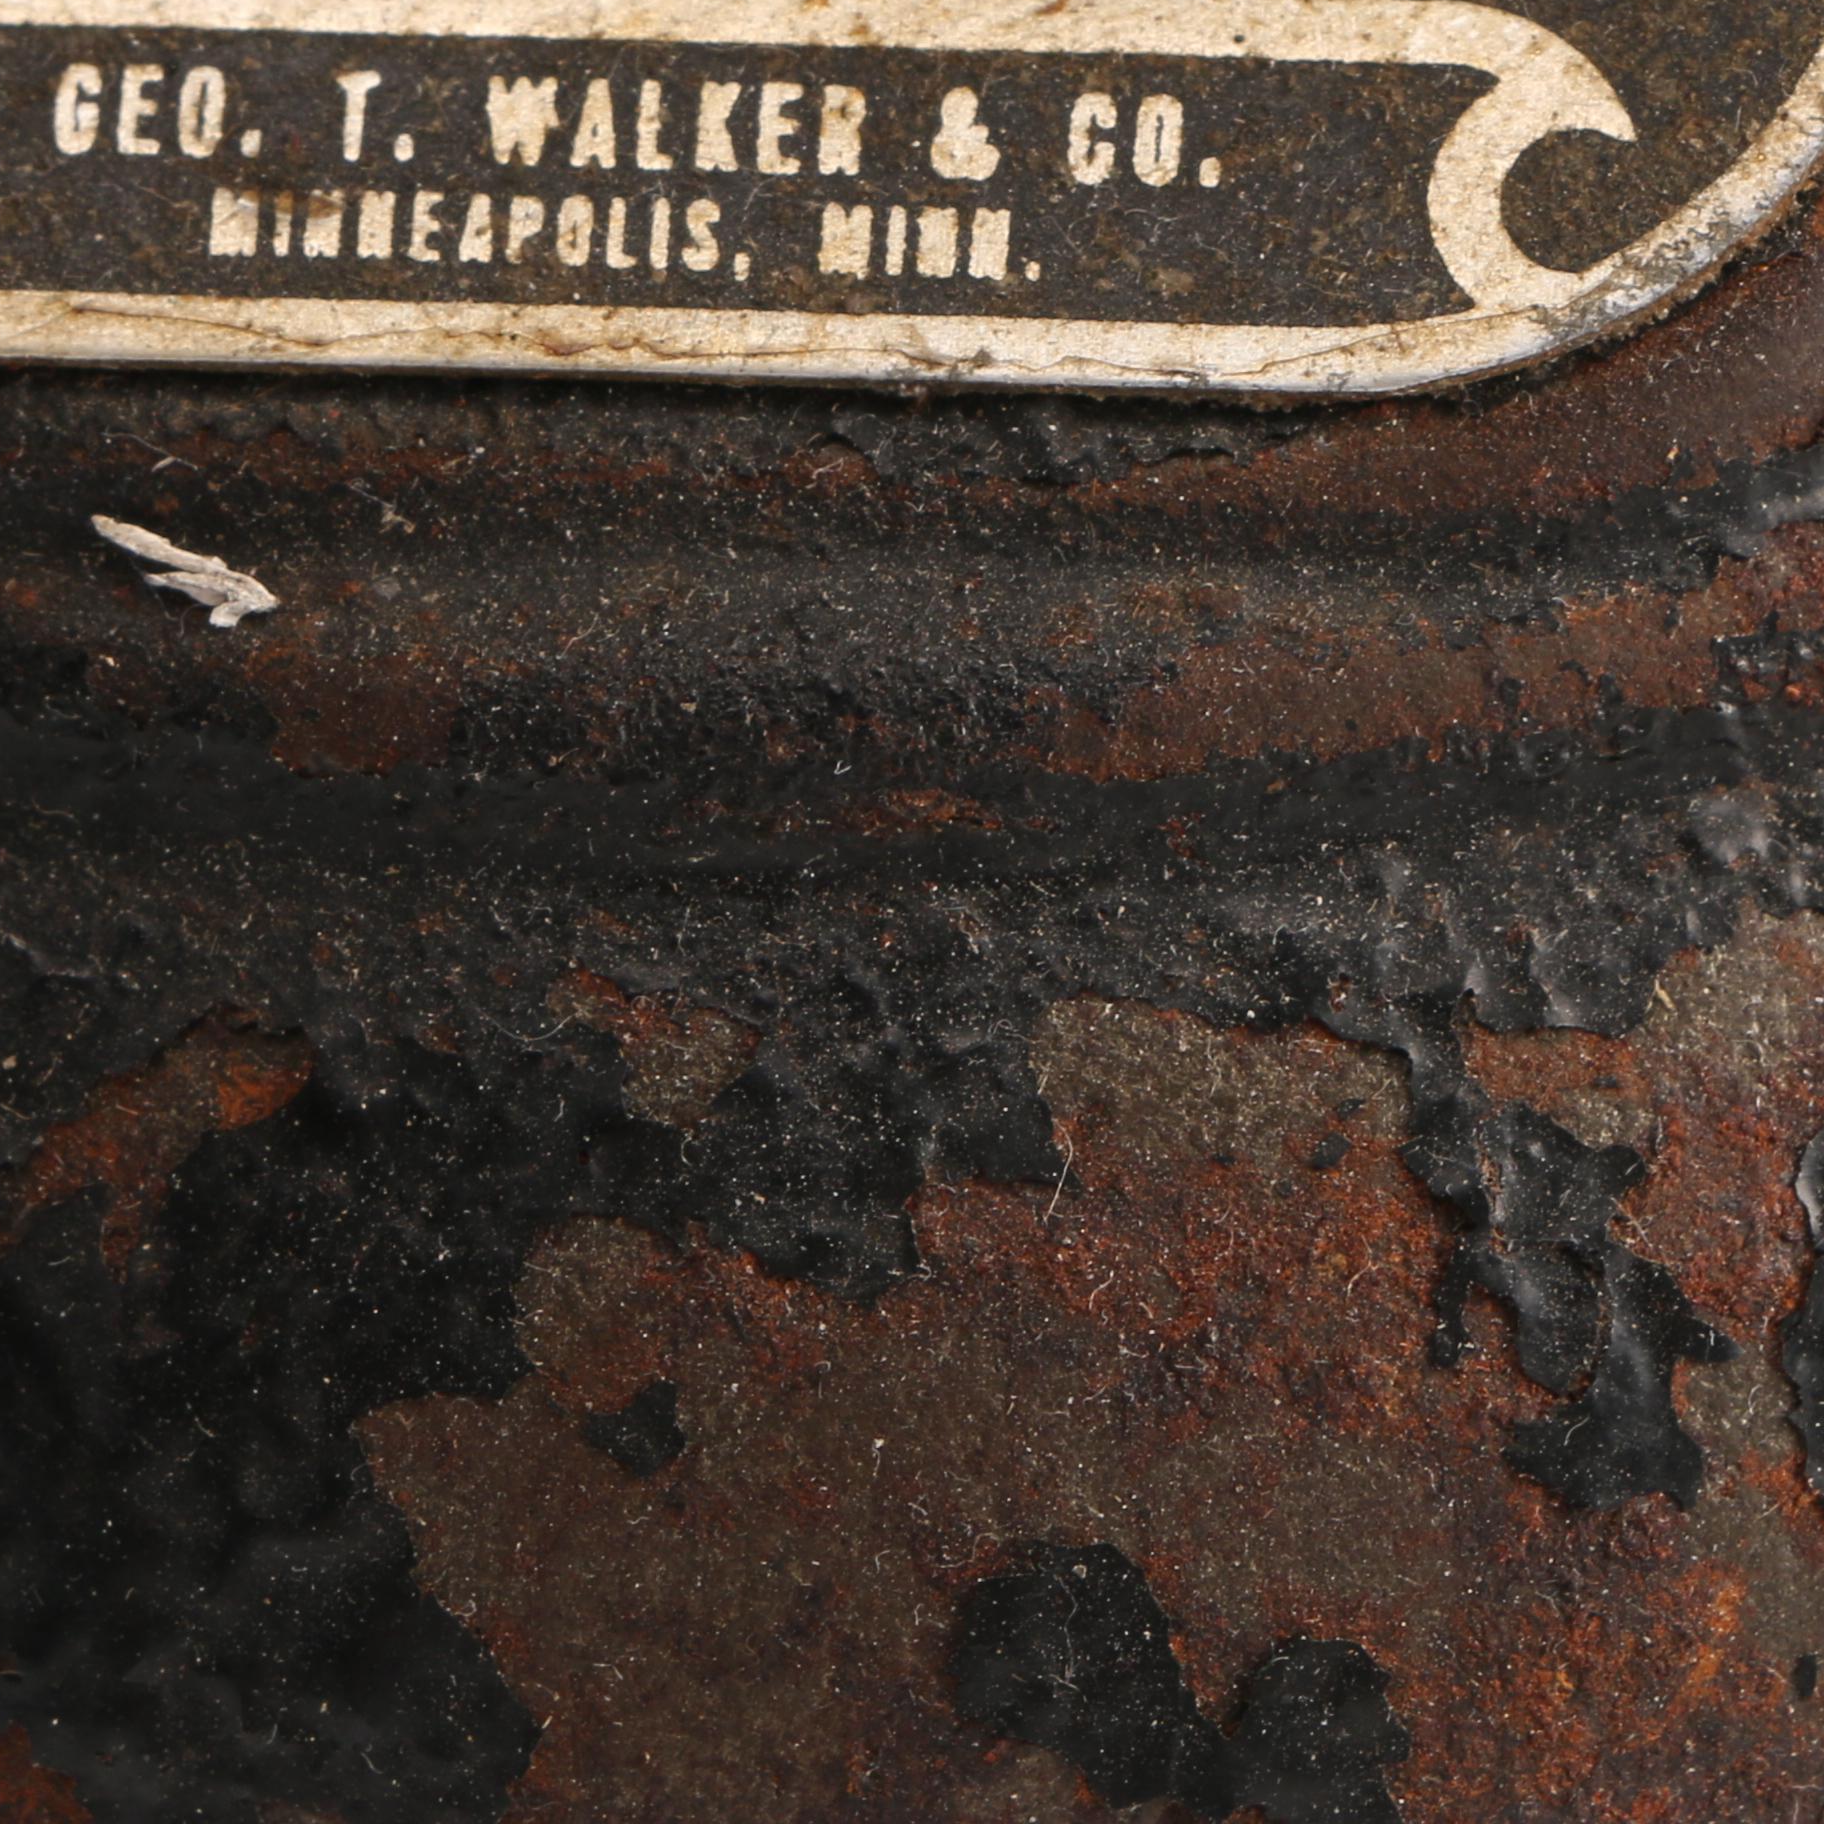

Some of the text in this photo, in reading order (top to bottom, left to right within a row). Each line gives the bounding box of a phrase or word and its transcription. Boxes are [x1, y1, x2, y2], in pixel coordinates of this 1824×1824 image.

[53, 63, 1221, 188] GEO. T. WALKER & CO.
[818, 201, 1040, 281] MINN.
